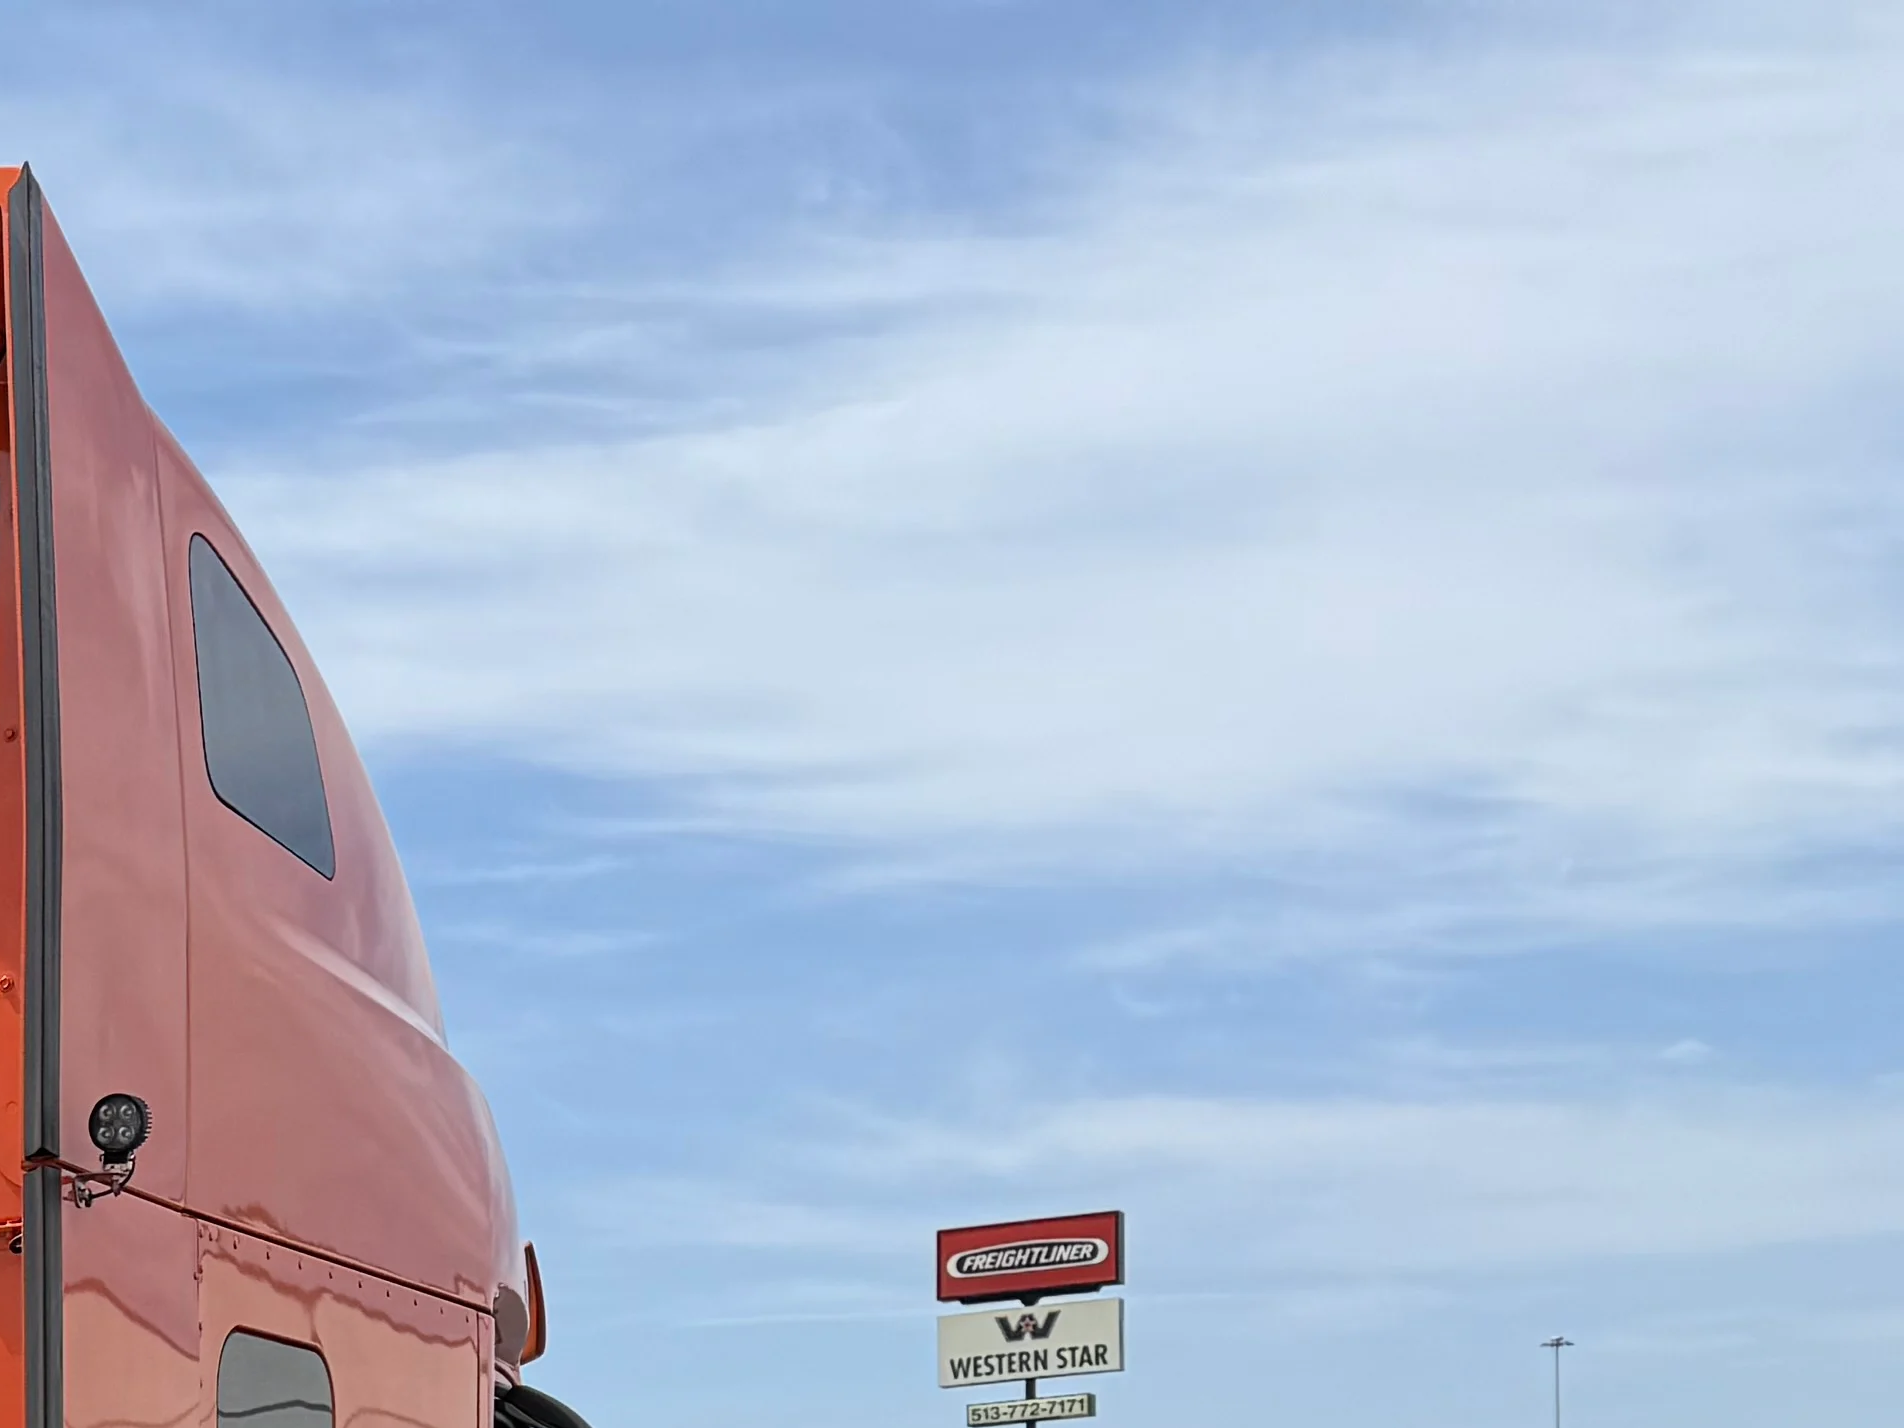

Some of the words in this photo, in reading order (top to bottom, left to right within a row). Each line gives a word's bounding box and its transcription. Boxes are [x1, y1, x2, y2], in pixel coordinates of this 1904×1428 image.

[962, 1244, 1094, 1273] FREIGHTLINER
[949, 1350, 1049, 1380] WESTERN
[1056, 1343, 1108, 1369] STAR
[970, 1397, 1086, 1423] 513-772-7171
